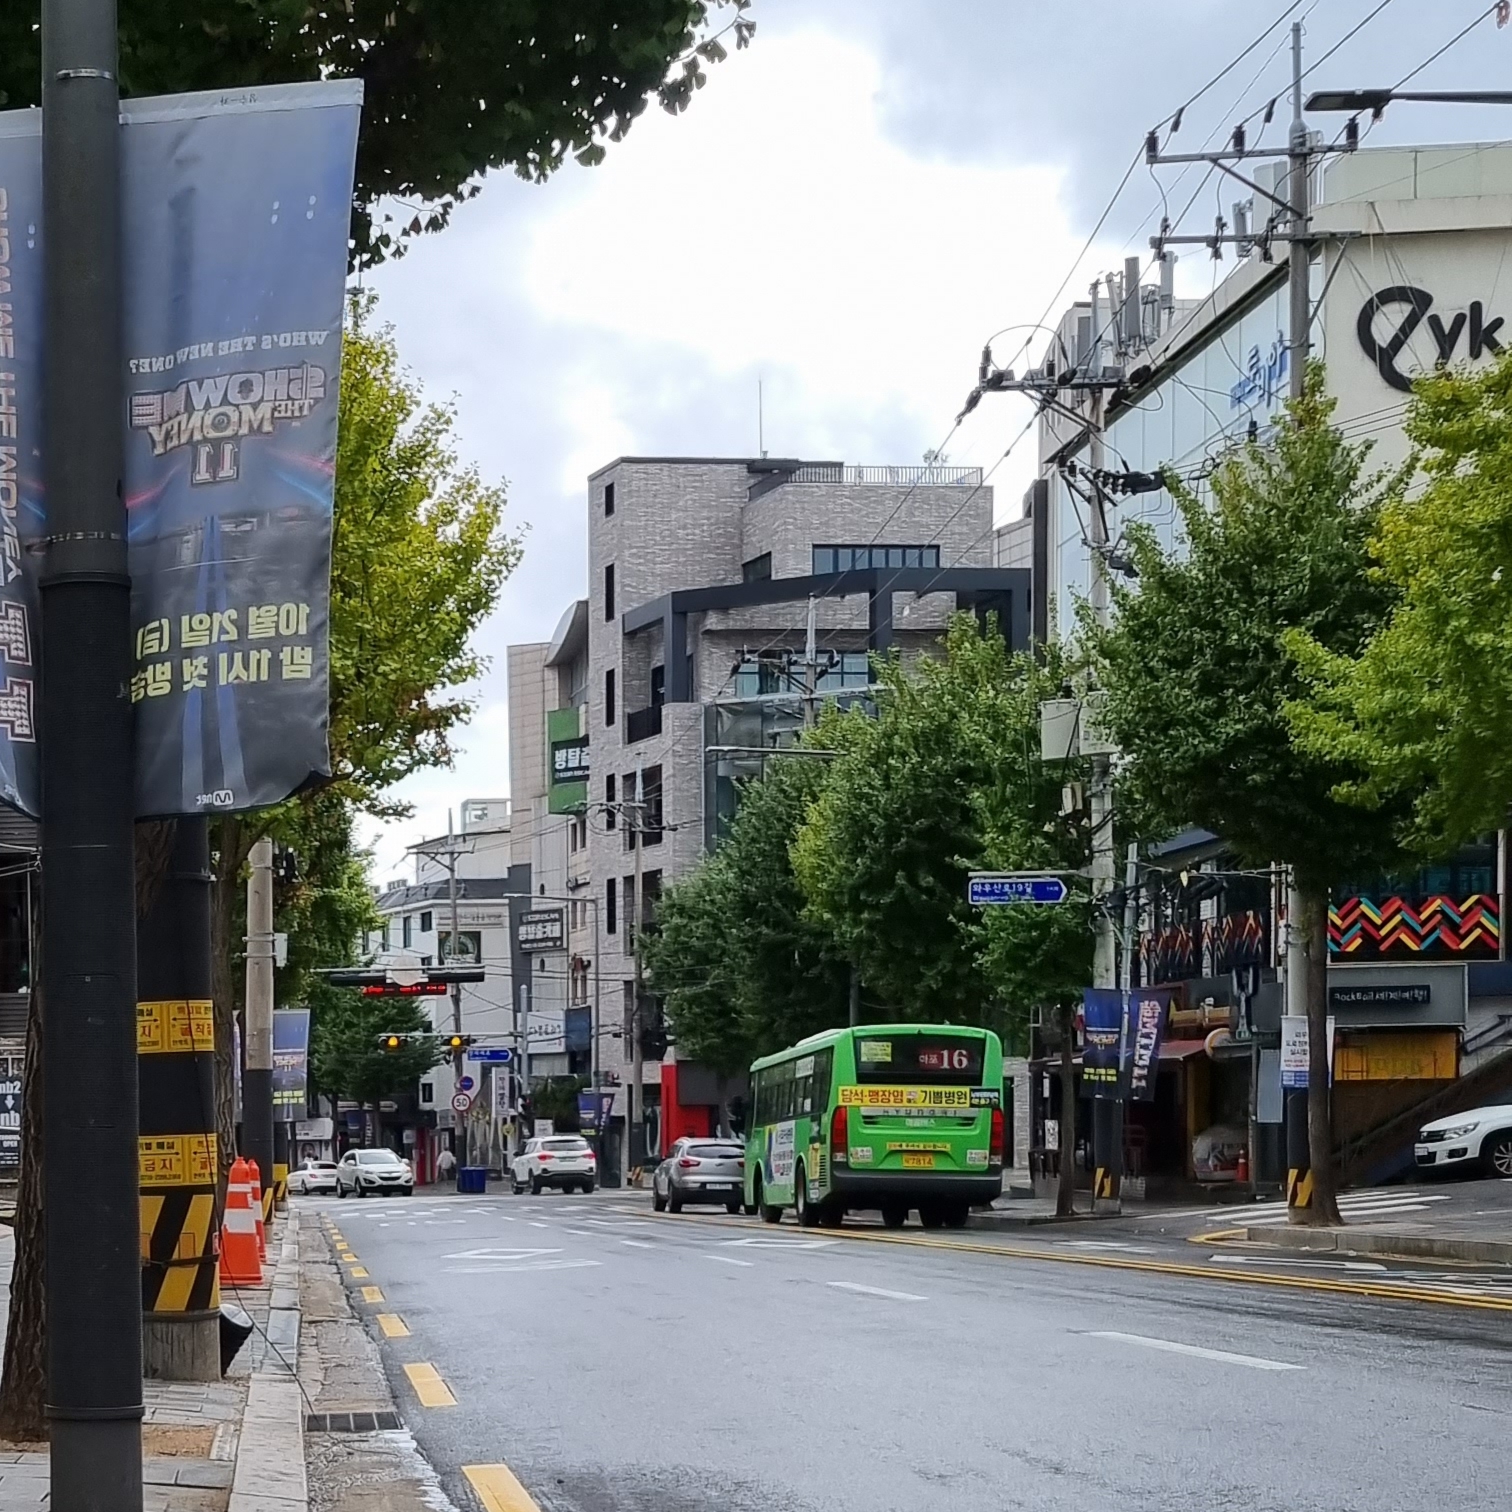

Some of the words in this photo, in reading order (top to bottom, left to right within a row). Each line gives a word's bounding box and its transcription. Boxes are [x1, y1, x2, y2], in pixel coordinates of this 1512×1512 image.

[939, 1049, 969, 1069] 16
[455, 1098, 467, 1107] 50
[920, 1089, 968, 1105] 기쁨병원
[0, 1110, 21, 1127] nb
